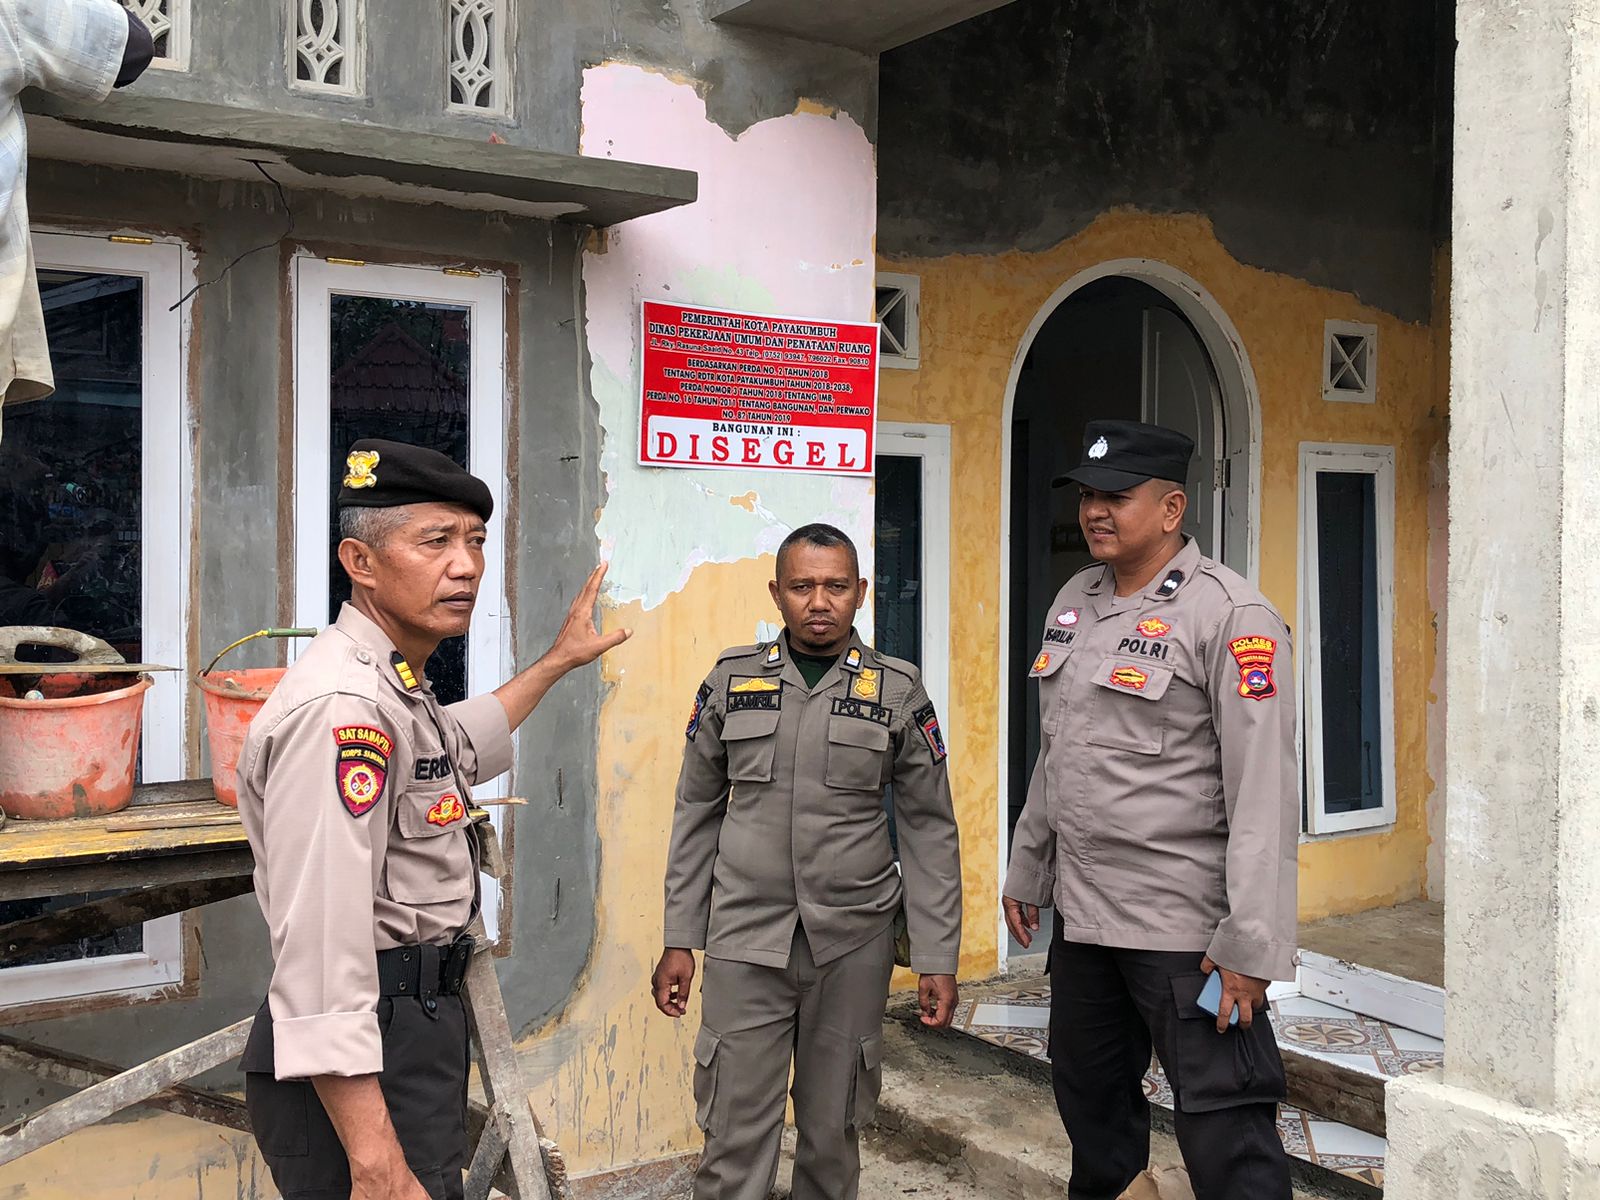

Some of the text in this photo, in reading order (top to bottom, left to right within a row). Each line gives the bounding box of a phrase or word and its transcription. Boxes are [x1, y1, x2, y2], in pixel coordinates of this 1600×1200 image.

[682, 312, 837, 337] PEMERINTAH KOTA PAYAKUMBUH
[649, 322, 871, 354] DINAS PEKERJAAN UMUM DAN PENATAAN RUANG
[677, 341, 700, 351] Rasuna
[736, 347, 744, 355] 43
[763, 351, 783, 360] (0752)
[687, 358, 829, 379] BERDASARKAN PERDA NO. 2 TAHUN 2018
[664, 368, 853, 393] TENTANG RDTR KOTA PAYAKUMBUH TAHUN 2018-2038,
[646, 391, 667, 401] PERDA
[668, 393, 682, 402] NO.
[684, 395, 692, 404] 16
[694, 396, 718, 405] TAHUN
[739, 399, 771, 410] TENTANG
[772, 402, 817, 414] BANGUNAN,
[819, 405, 834, 414] DAN
[836, 406, 870, 416] PERWAKO
[680, 382, 835, 403] PERDA NOMOR 3 TAHUN 2018 TENTANG IMB,
[722, 410, 736, 419] NO.
[747, 412, 772, 421] TAHUN
[774, 414, 791, 423] 2019
[712, 422, 774, 436] BANGUNAN
[777, 427, 794, 437] INI
[656, 431, 856, 468] DISEGEL
[1117, 637, 1169, 660] POLRI
[1231, 637, 1273, 649] POLRES
[839, 701, 887, 721] POL PP
[338, 728, 390, 753] SAT SAMAPTA
